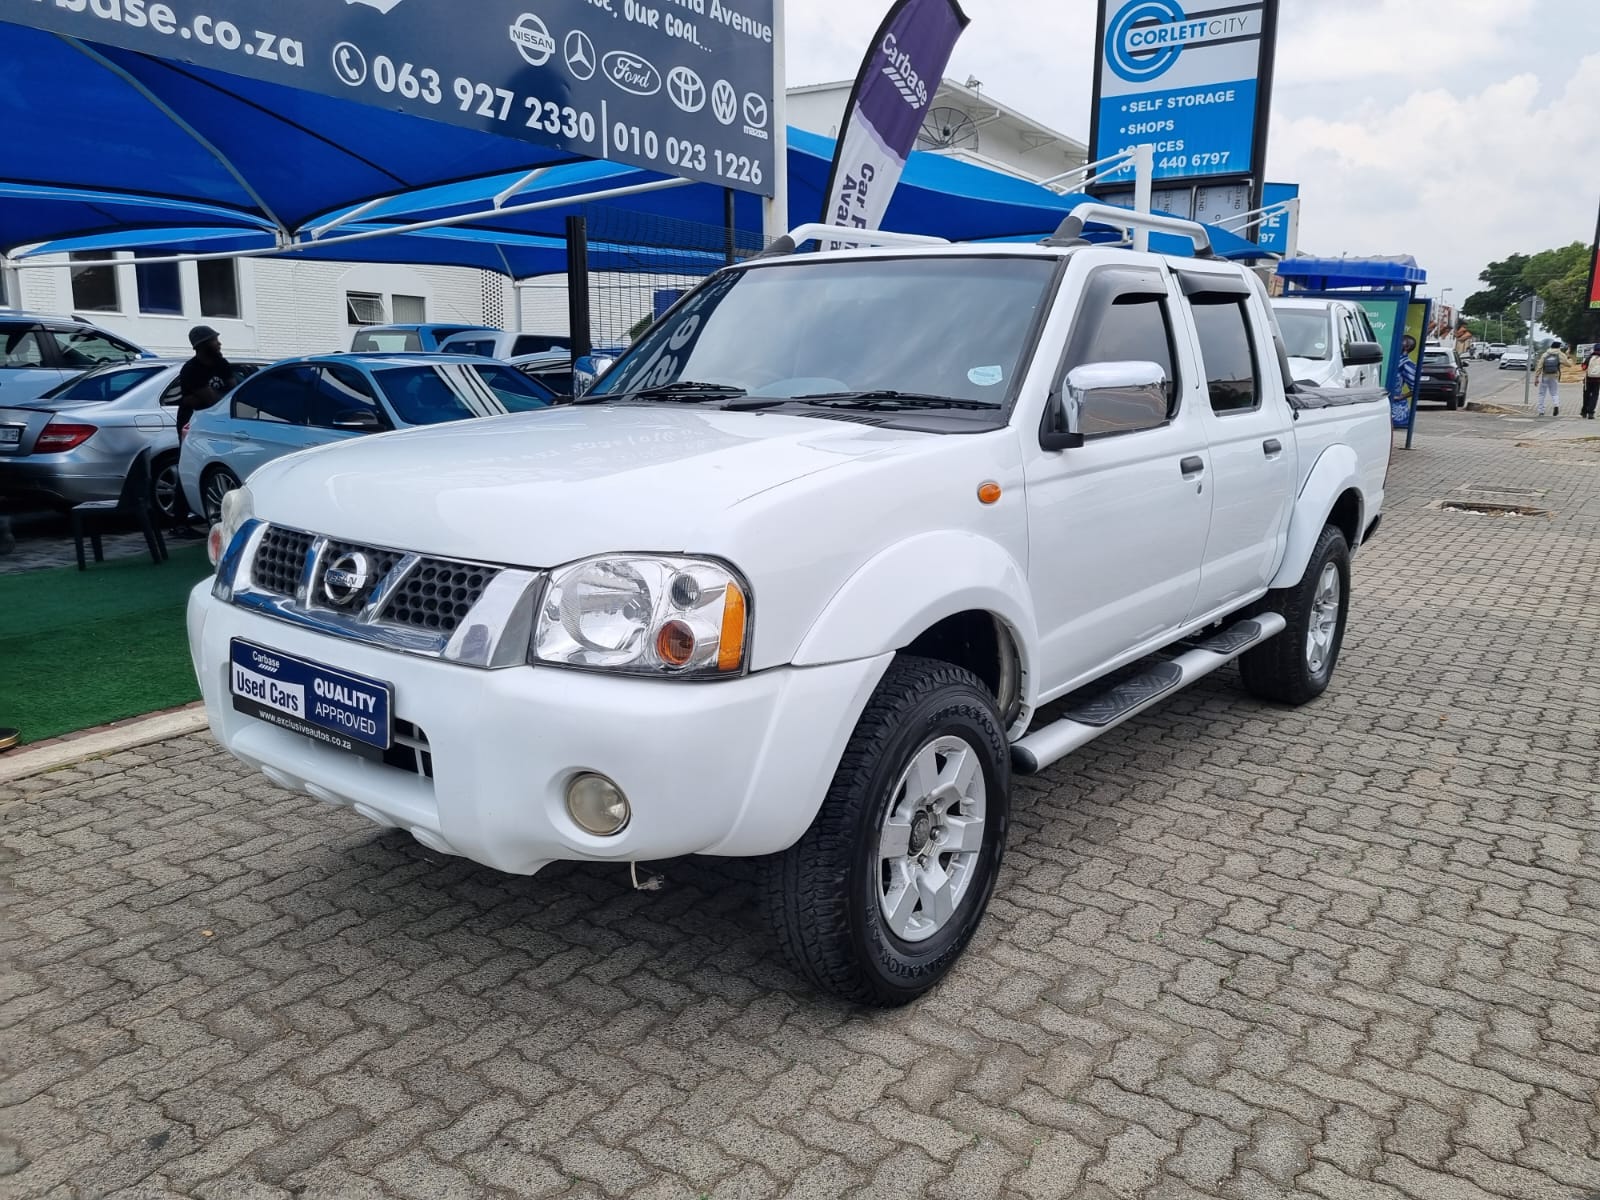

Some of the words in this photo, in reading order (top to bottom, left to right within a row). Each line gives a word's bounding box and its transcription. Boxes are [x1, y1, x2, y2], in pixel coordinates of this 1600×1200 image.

[512, 29, 553, 50] NISSAN
[613, 57, 651, 88] Ford
[882, 33, 927, 105] Carbase
[373, 55, 442, 104] 063
[453, 77, 514, 121] 927
[524, 97, 595, 142] 2330
[1129, 98, 1163, 113] SELF
[1167, 90, 1235, 109] STORAGE
[1127, 120, 1175, 135] SHOPS
[613, 122, 659, 160] 010
[666, 136, 706, 171] 023
[713, 149, 763, 185] 1226
[1159, 155, 1187, 168] 440
[1191, 152, 1230, 167] 6797
[856, 163, 874, 208] Car
[252, 651, 280, 668] Carbase
[236, 670, 266, 700] Used
[269, 681, 298, 711] Cars
[313, 677, 377, 713] QUALITY
[258, 708, 352, 749] www.exclusiveautos.co.za
[315, 701, 377, 735] APPROVED
